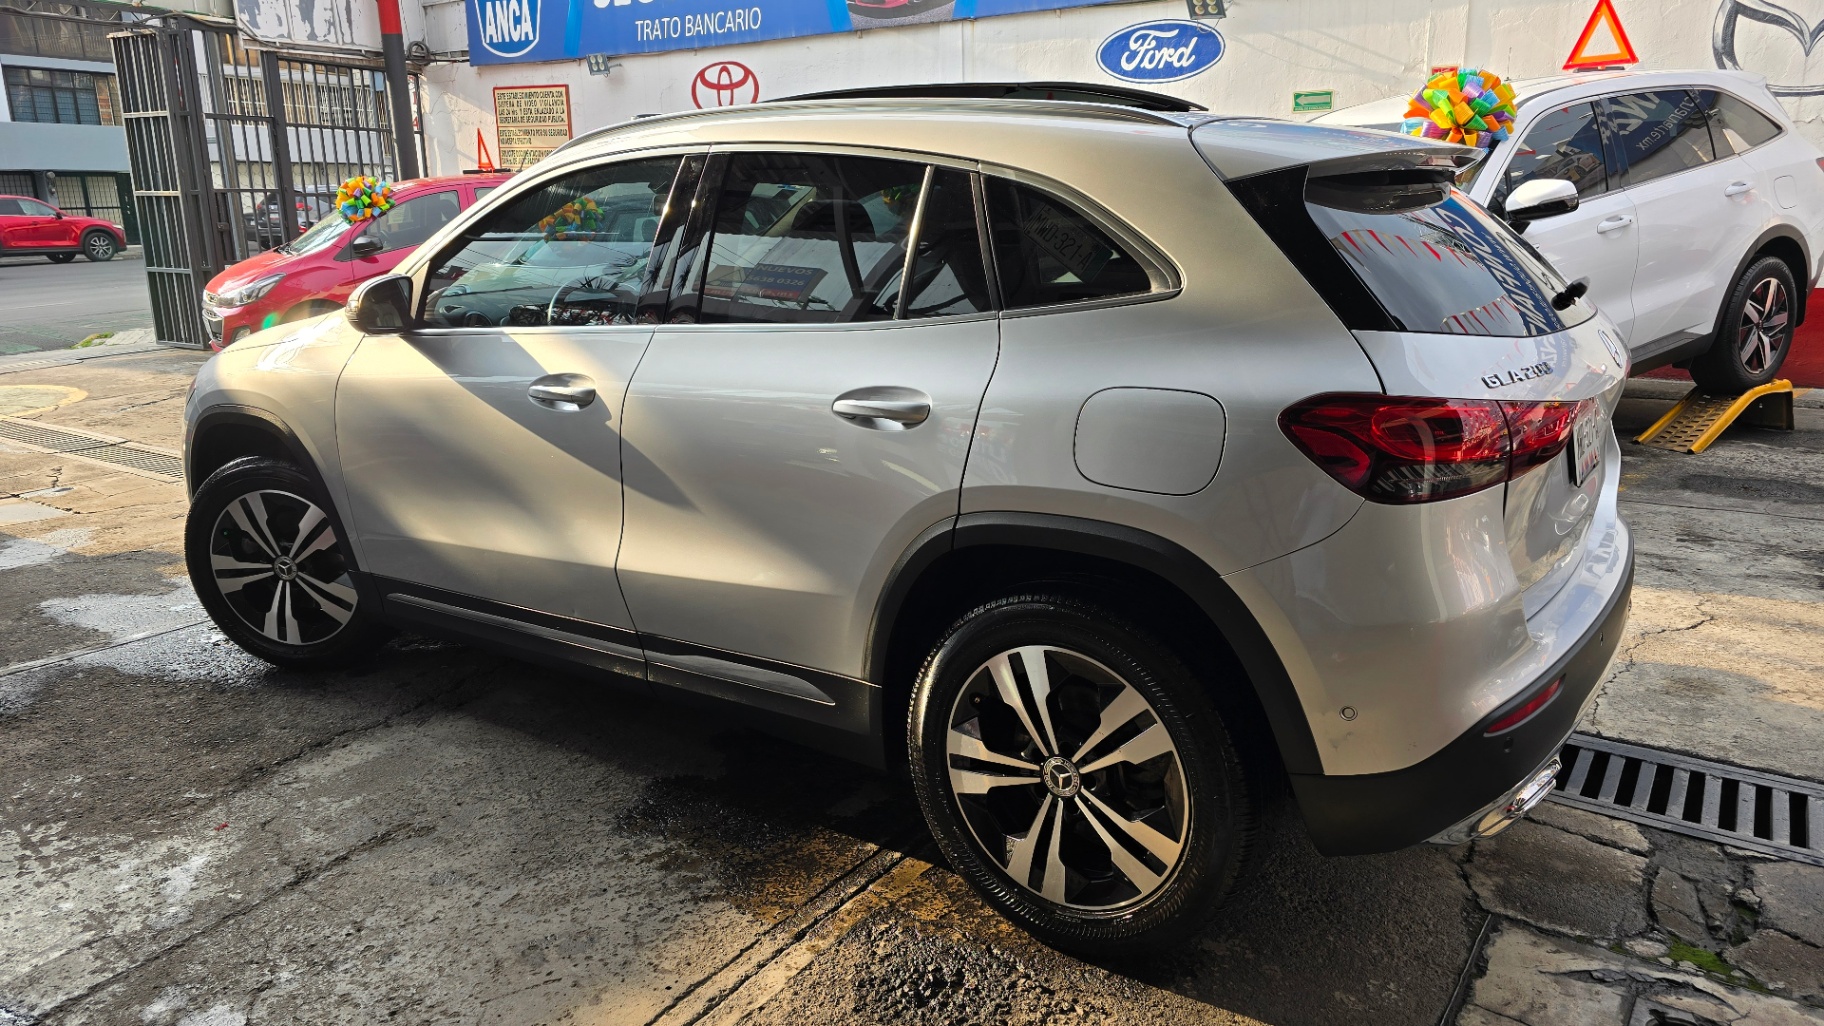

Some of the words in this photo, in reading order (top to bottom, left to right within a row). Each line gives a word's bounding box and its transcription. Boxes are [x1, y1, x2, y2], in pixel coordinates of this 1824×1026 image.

[485, 0, 534, 43] ANCA
[635, 18, 681, 41] TRATO
[685, 7, 762, 36] BANCARIO
[1120, 28, 1198, 71] Ford
